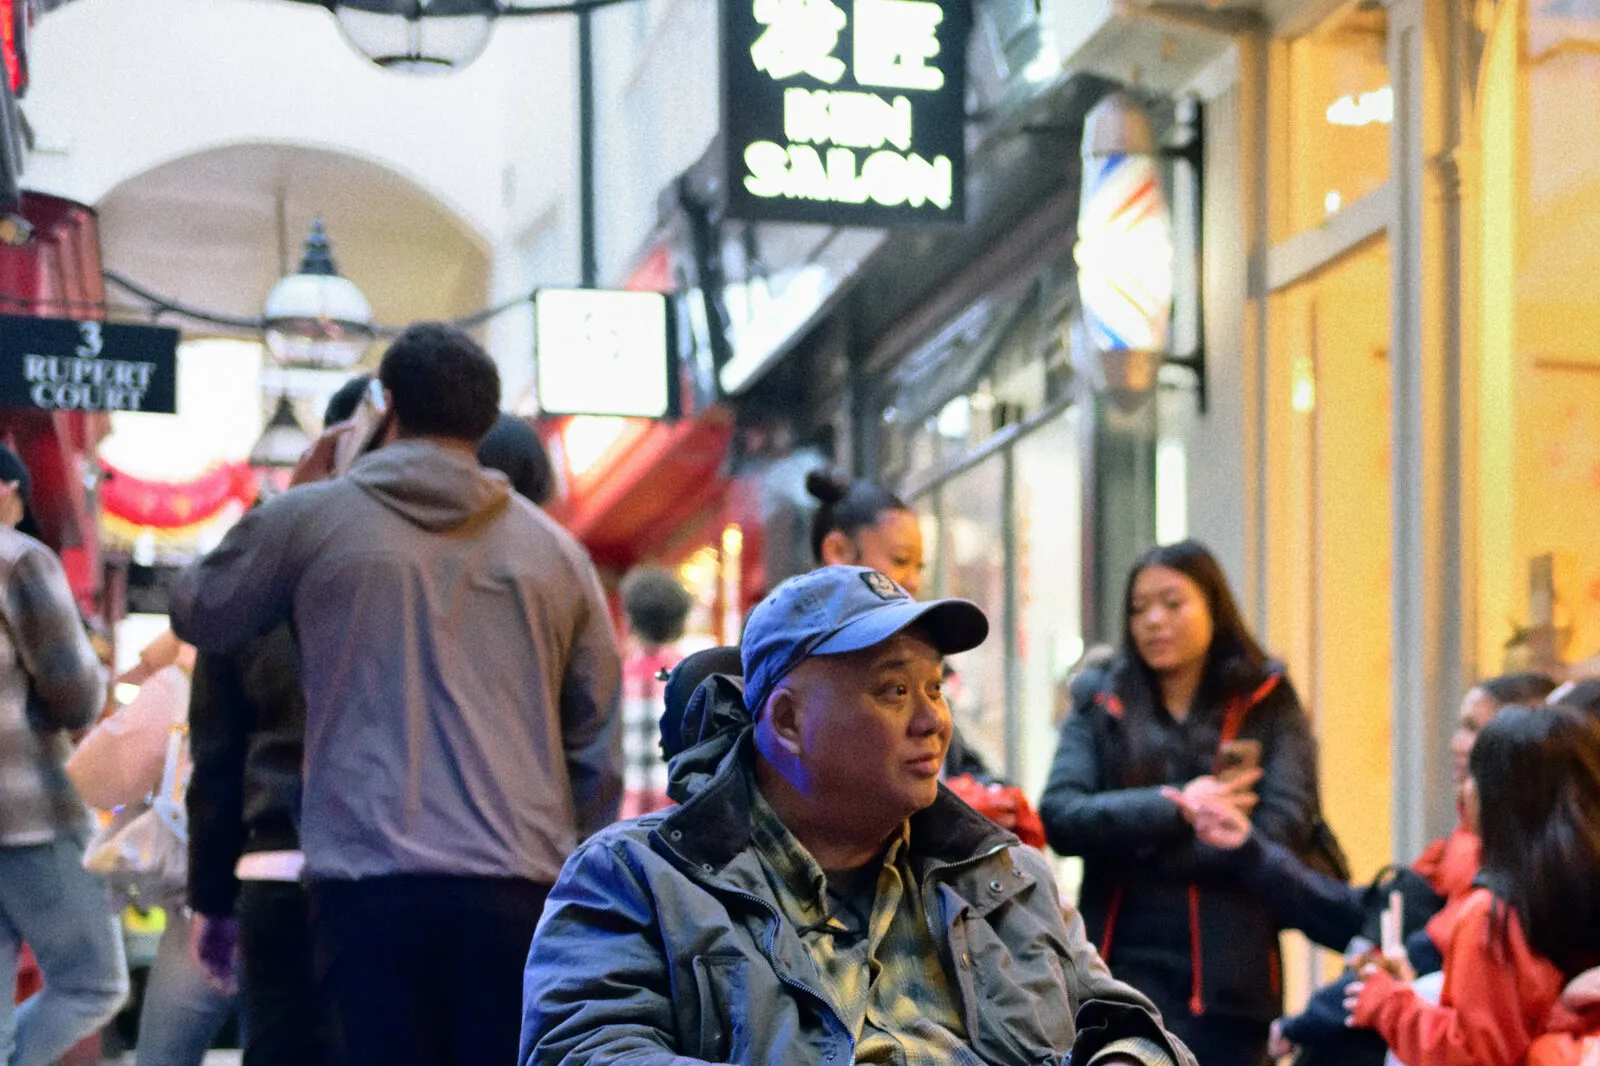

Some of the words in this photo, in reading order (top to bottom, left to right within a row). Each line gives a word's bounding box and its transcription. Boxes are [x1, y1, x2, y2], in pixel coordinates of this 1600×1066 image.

[743, 140, 952, 210] SALON
[76, 320, 103, 358] 3
[23, 353, 156, 391] RUPERT
[31, 382, 147, 411] COURT
